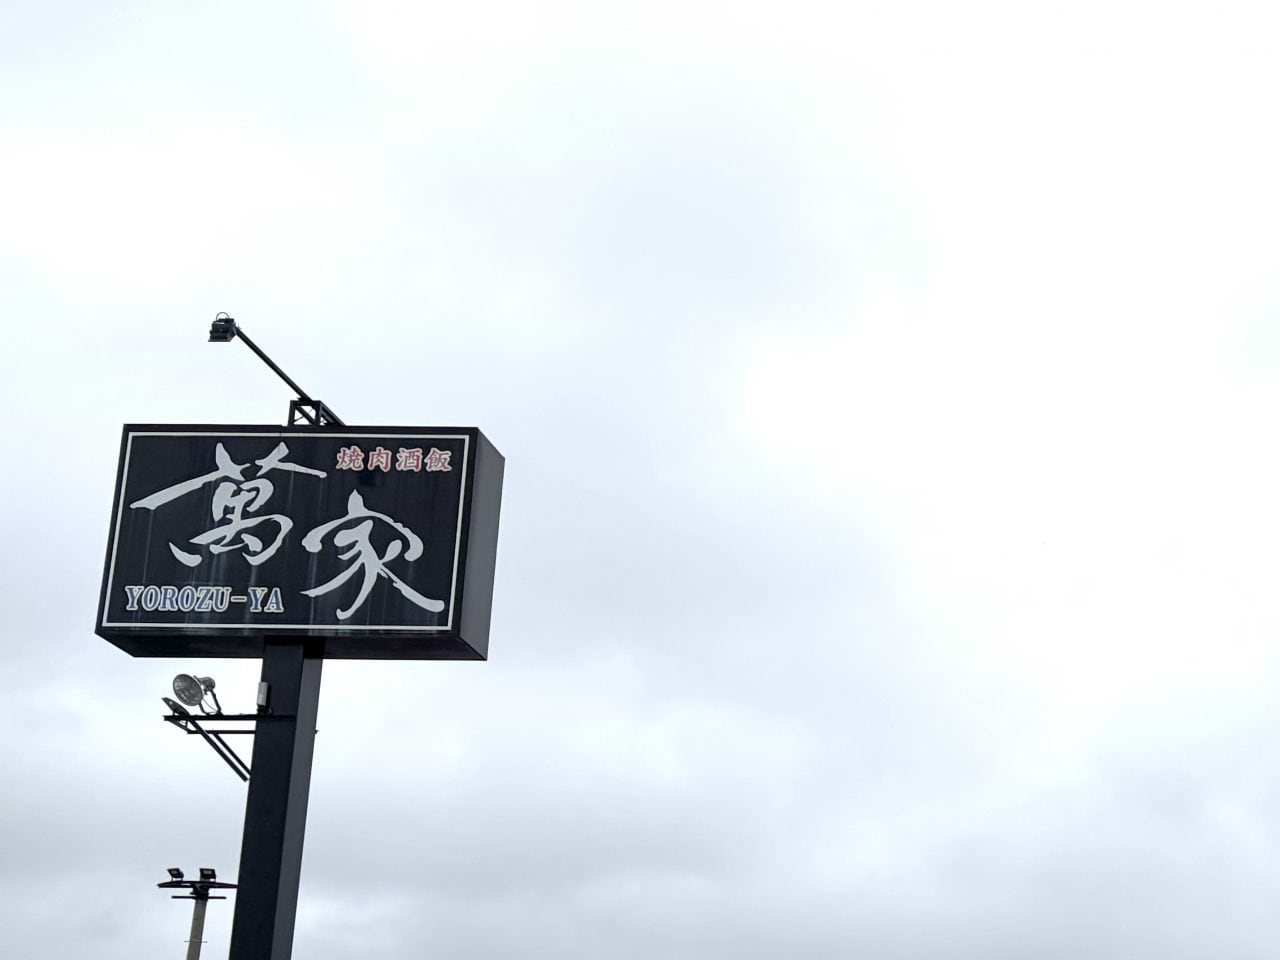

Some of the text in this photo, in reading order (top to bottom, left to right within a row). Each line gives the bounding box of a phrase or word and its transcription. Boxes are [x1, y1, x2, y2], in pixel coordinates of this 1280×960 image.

[336, 446, 452, 472] 焼肉酒飯
[130, 441, 445, 620] 萬家
[125, 585, 284, 613] YOROZU-YA
